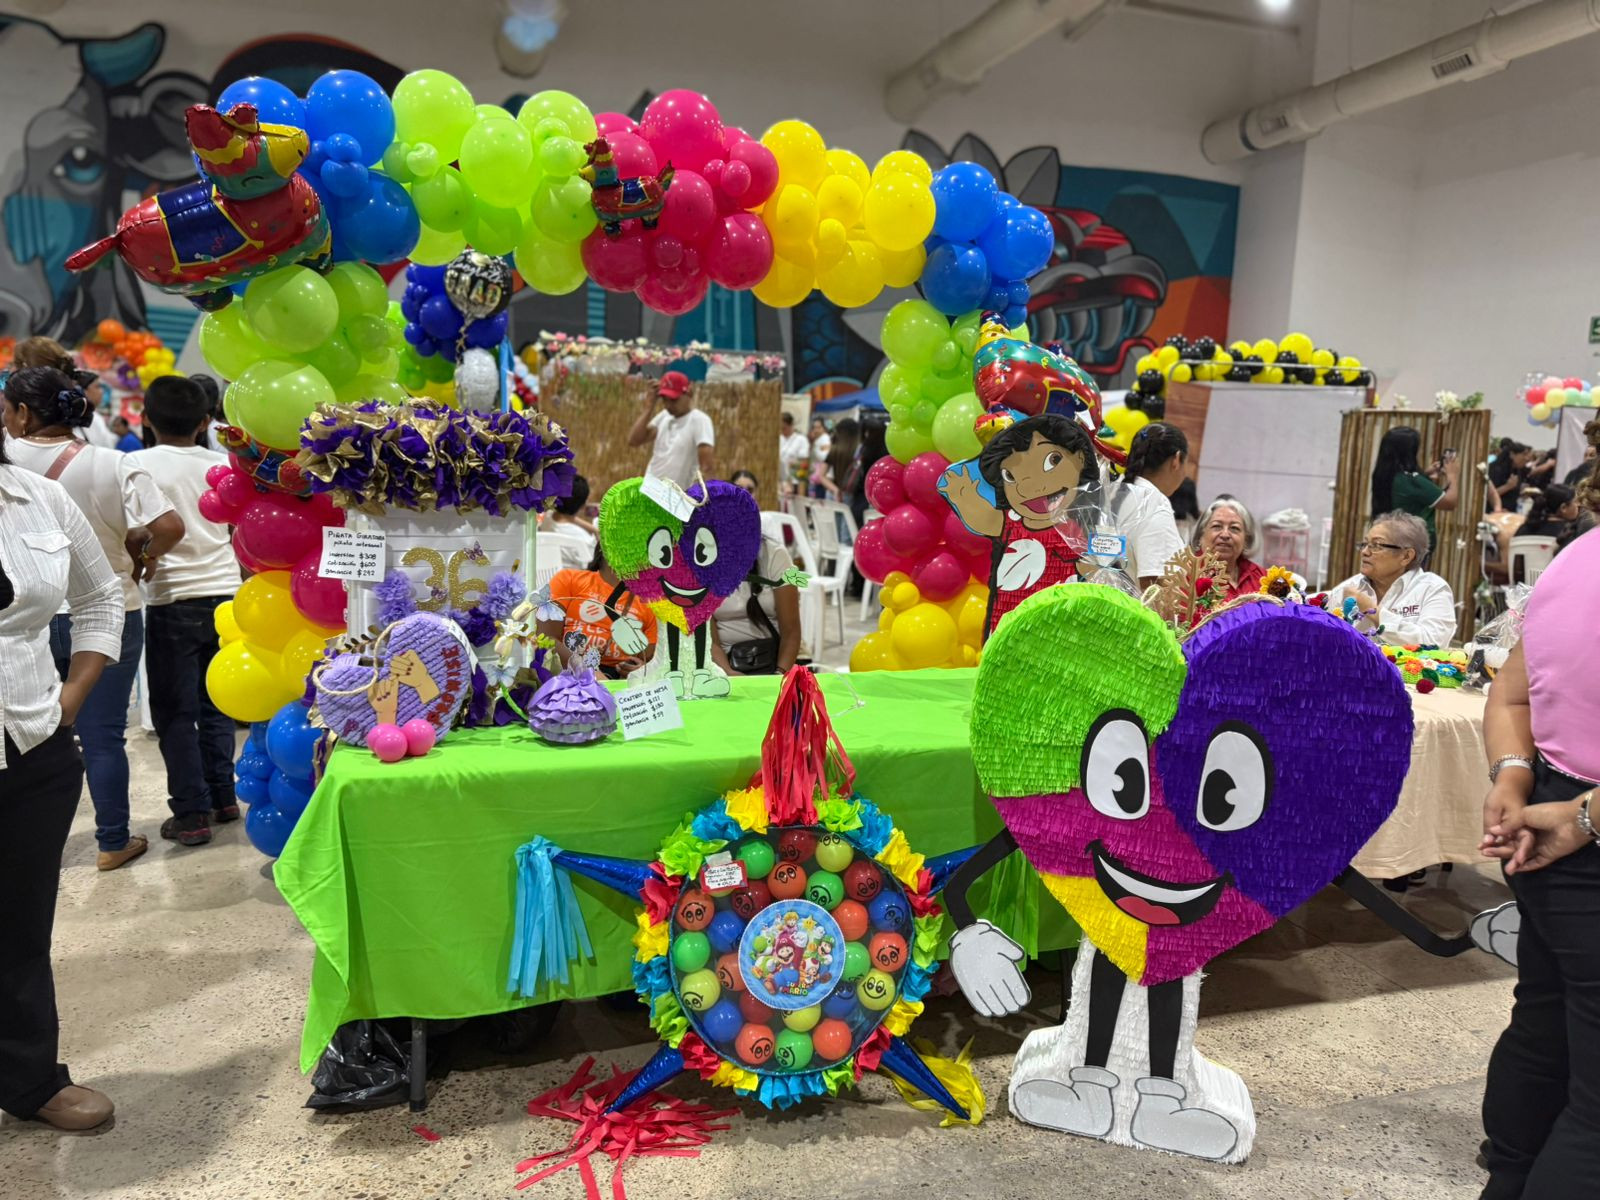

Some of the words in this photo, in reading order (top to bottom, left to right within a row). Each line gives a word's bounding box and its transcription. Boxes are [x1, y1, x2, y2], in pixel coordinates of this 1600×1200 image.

[360, 561, 377, 569] $600
[400, 546, 491, 612] 36
[1402, 604, 1420, 614] DIF
